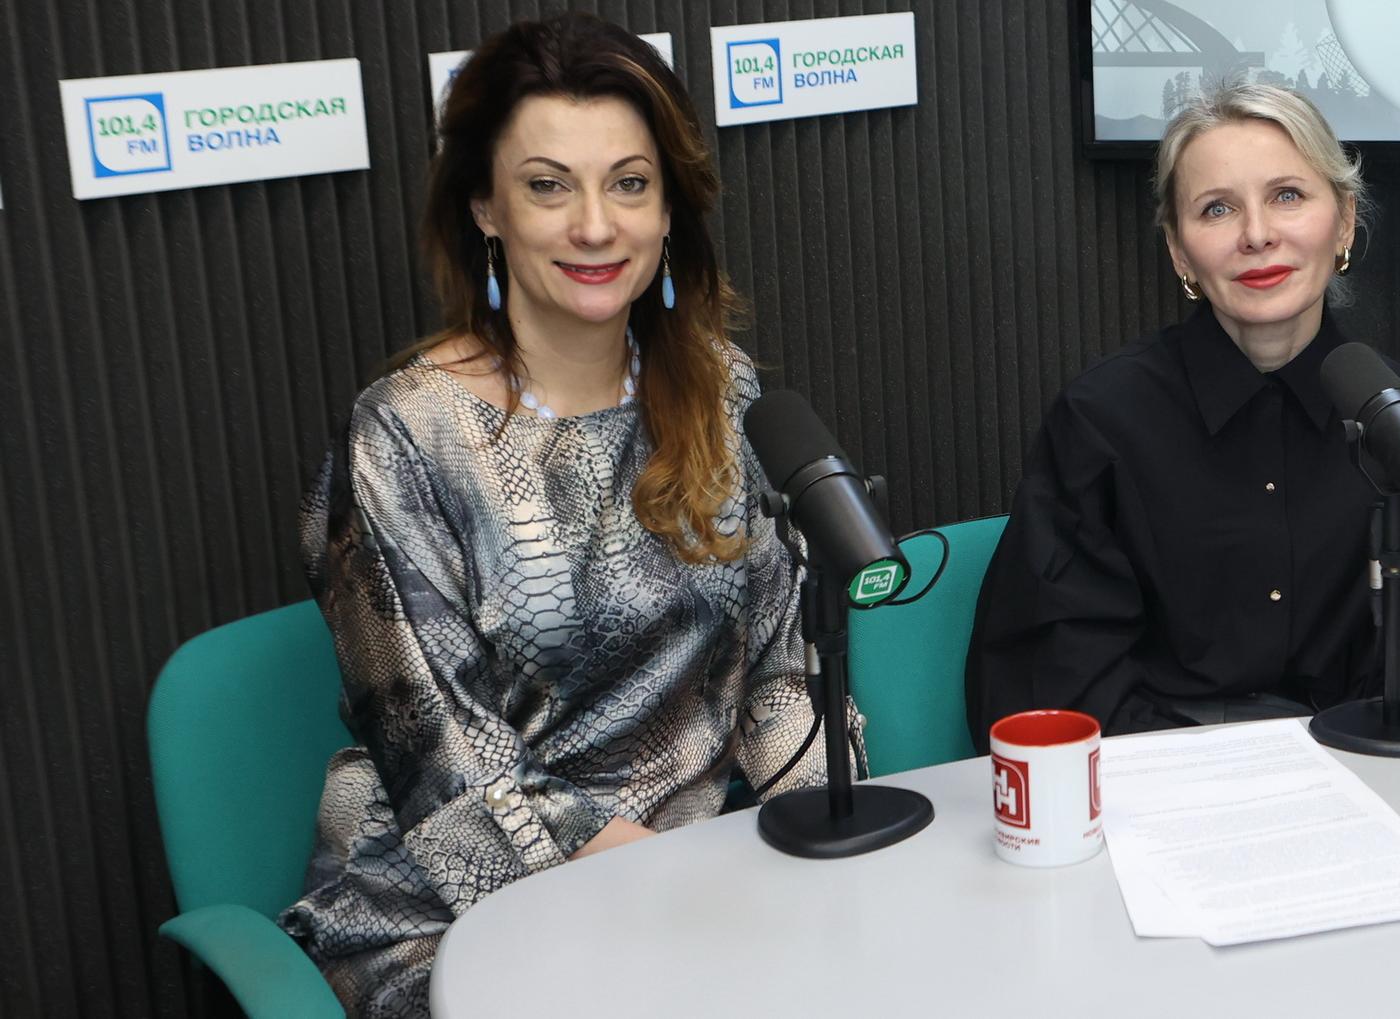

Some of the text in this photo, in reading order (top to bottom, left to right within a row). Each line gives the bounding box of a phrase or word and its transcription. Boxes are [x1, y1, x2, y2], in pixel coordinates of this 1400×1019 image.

[735, 56, 774, 75] 101,4
[792, 44, 904, 68] ГОРОДСКАЯ
[753, 77, 774, 90] FM
[794, 68, 858, 88] ВОЛНА
[184, 96, 348, 129] ГОРОДСКАЯ
[97, 113, 157, 136] 101,4
[127, 139, 159, 155] FM
[187, 127, 281, 152] ВОЛНА
